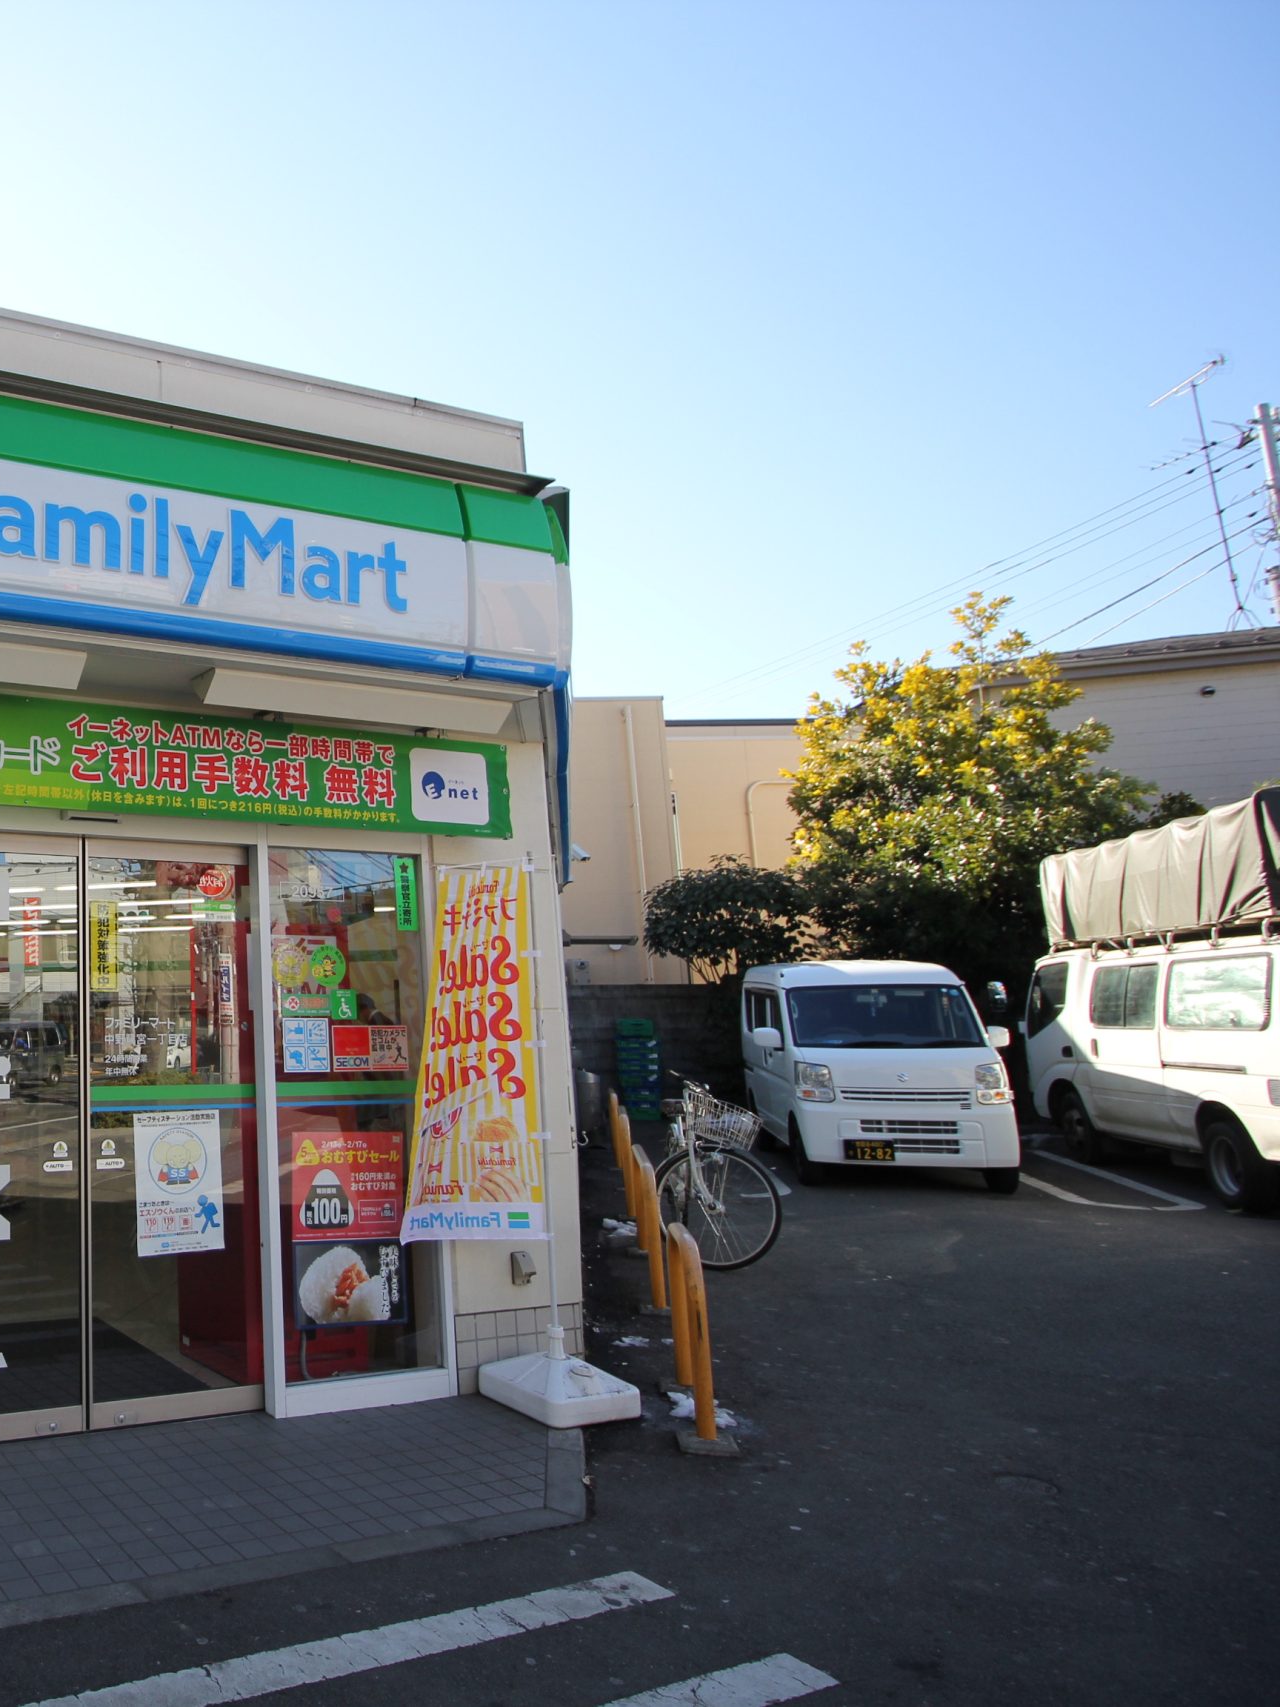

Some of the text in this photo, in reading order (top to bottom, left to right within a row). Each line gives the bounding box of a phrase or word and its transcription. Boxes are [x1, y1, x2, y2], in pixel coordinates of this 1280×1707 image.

[67, 713, 396, 766] イーネットATMなら一部時間帯で
[71, 741, 397, 808] ご利用手数料 無料
[104, 1017, 176, 1029] ファミリーマート
[336, 1057, 369, 1068] SECOM
[321, 1149, 400, 1164] おむすびセール
[856, 1148, 892, 1160] 12-82
[170, 1168, 186, 1178] SS
[311, 1197, 348, 1225] 100円
